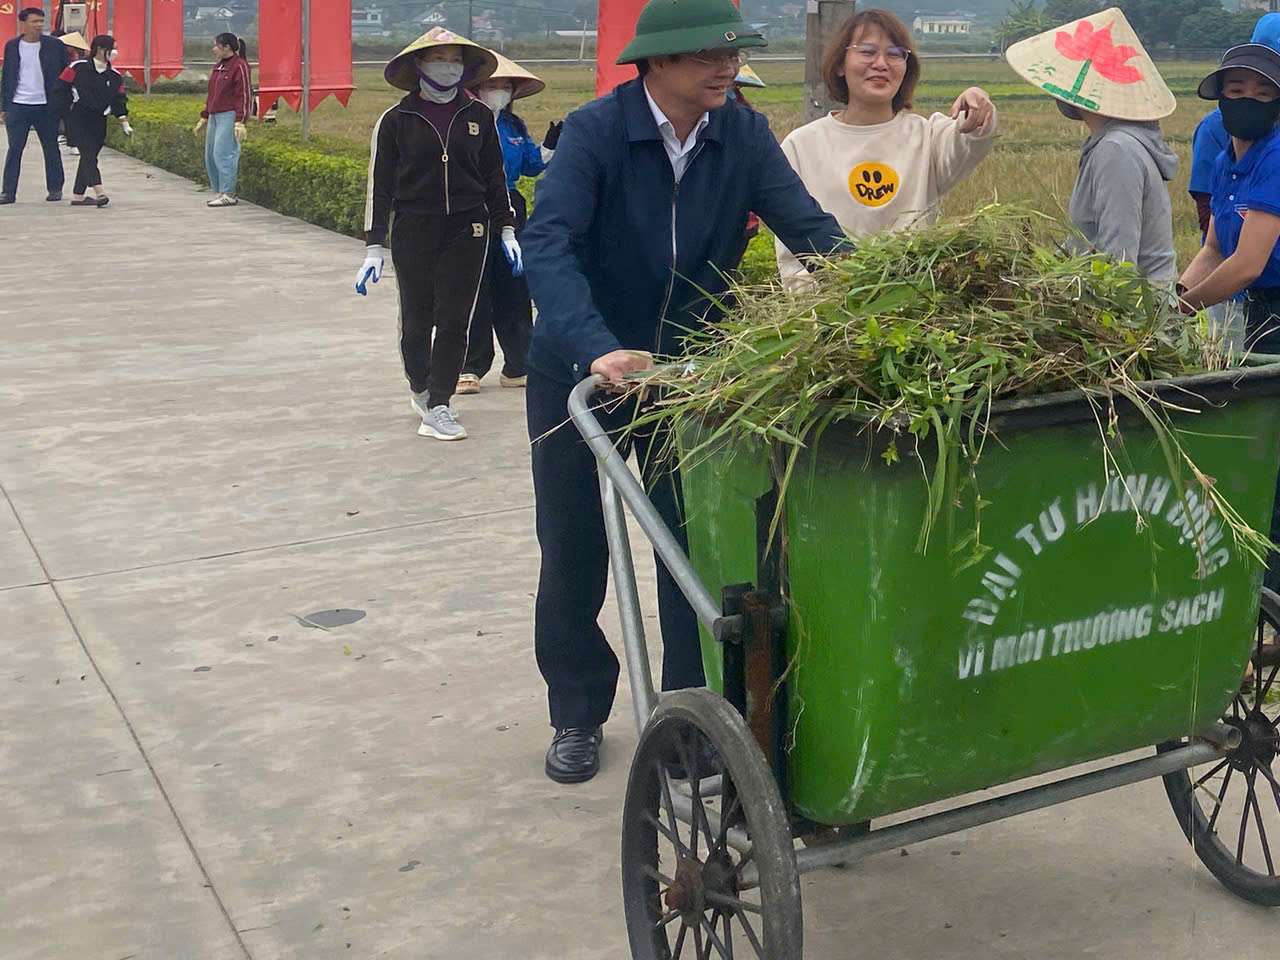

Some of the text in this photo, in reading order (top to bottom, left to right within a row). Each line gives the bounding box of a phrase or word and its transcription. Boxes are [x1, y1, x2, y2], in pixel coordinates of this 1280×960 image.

[856, 183, 895, 201] DREW
[471, 222, 485, 237] B
[1158, 588, 1224, 635] SẠCH
